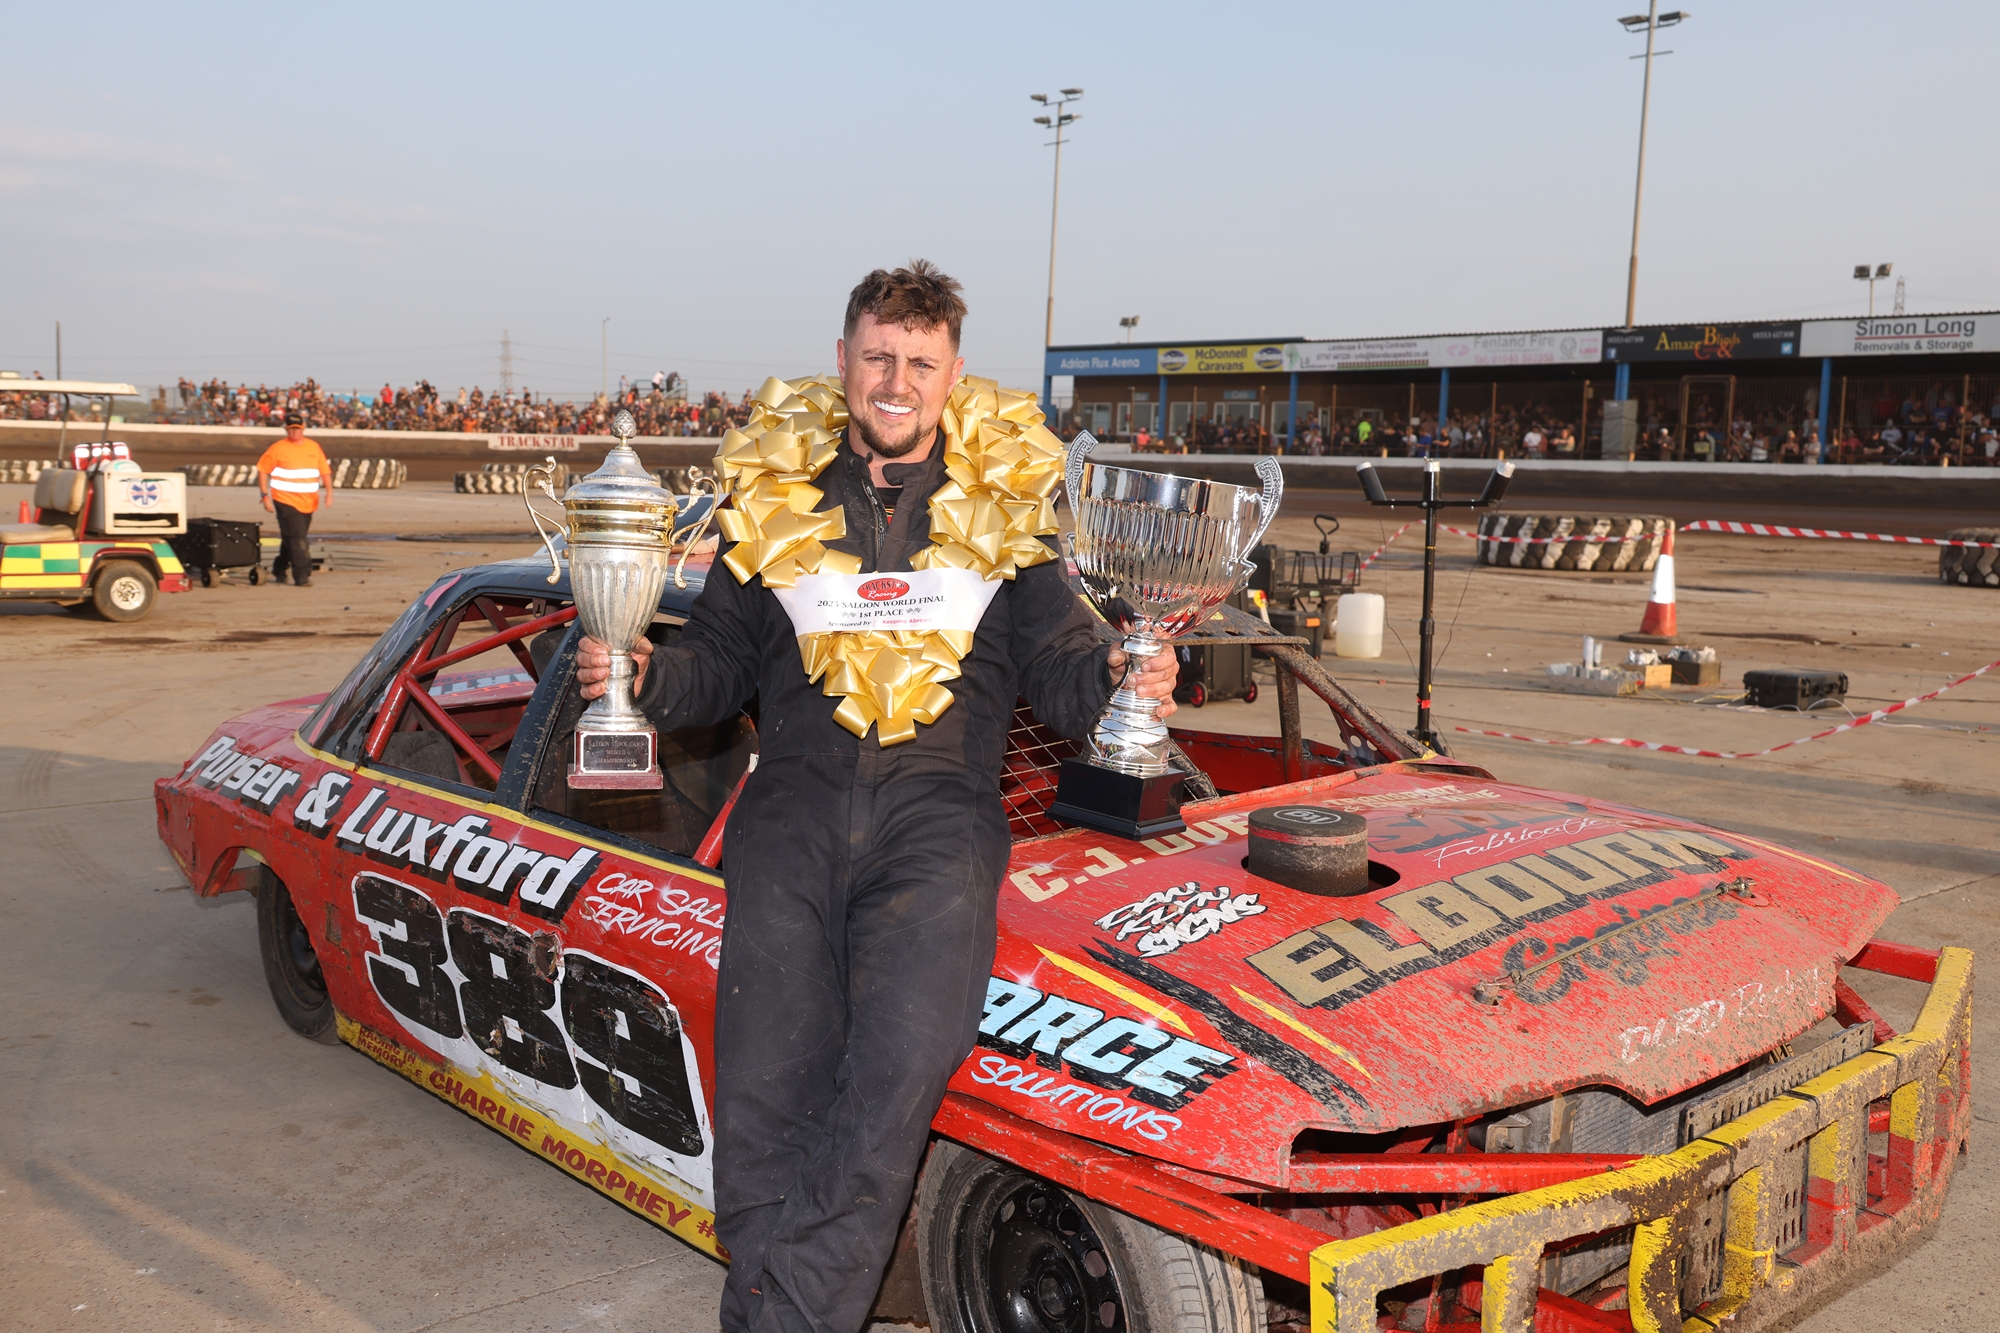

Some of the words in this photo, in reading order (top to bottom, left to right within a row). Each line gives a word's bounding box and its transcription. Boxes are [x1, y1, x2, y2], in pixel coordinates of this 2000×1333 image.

[1655, 331, 1702, 350] Amaze
[1704, 326, 1741, 346] Blinds
[1856, 320, 1917, 336] Simon
[1925, 319, 1976, 337] Long
[1195, 347, 1248, 359] McDonnell
[1328, 342, 1356, 351] Landscape
[1363, 341, 1384, 350] Fencing
[1385, 341, 1418, 349] Contractors
[1474, 336, 1526, 349] Fenland
[1530, 335, 1555, 348] Fire
[1854, 341, 1910, 352] Removals
[1914, 340, 1923, 350] &
[1927, 340, 1974, 352] Storage
[1060, 358, 1090, 369] Adrian
[1092, 357, 1109, 369] Flux
[1111, 357, 1140, 369] Arena
[1198, 360, 1245, 372] Caravans
[498, 435, 540, 447] TRACK
[543, 436, 575, 448] STAR
[842, 601, 880, 609] SALOON
[883, 597, 917, 607] WORLD
[919, 595, 946, 604] FINAL
[868, 590, 897, 599] Racing
[874, 609, 904, 617] PLACE
[1322, 785, 1463, 806] TRANSPORT
[1442, 789, 1501, 803] HIRE
[186, 736, 300, 805] Purser
[294, 771, 351, 829] &
[337, 786, 598, 910] Luxford
[1009, 847, 1146, 902] C.J.
[1141, 812, 1250, 856] OVE
[597, 873, 654, 909] CAR
[1136, 893, 1268, 960] SIGNS
[1244, 829, 1740, 1009] ELBOURN
[580, 896, 722, 970] SERVICING
[1502, 888, 1747, 1005] Engines
[353, 872, 707, 1160] 389
[357, 1036, 405, 1069] MEMORY
[359, 1027, 401, 1055] RACING
[403, 1051, 417, 1065] IN
[971, 1056, 1183, 1141] SOLUTIONS
[429, 1070, 535, 1141] CHARLIE
[541, 1136, 693, 1228] MORPHEY
